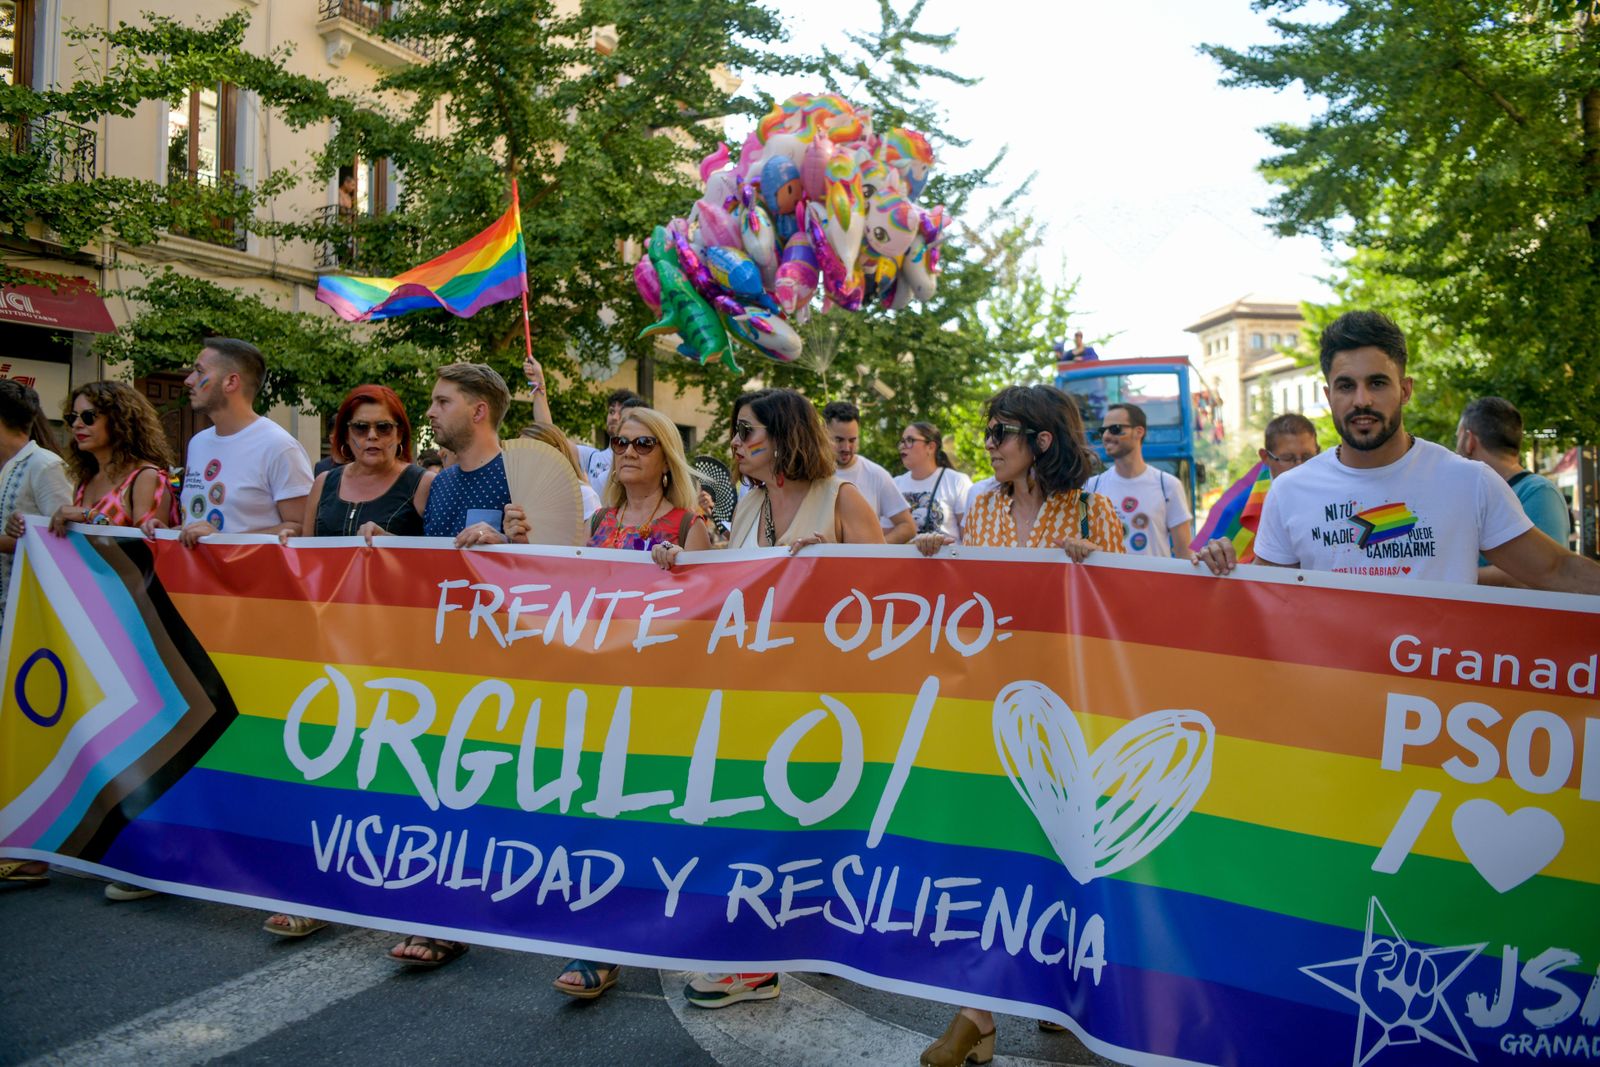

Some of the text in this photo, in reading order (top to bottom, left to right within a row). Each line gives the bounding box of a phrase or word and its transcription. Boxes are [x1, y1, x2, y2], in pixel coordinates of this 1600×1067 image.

[1325, 504, 1337, 522] NI
[1312, 527, 1434, 546] NI NADIE PUEDE
[1366, 541, 1436, 559] CAMBIARME
[435, 579, 1014, 661] FRENTE AL ODIO:
[1389, 634, 1598, 695] Granad
[311, 814, 1109, 986] VISIBILIDAD Y RESILIENCIA
